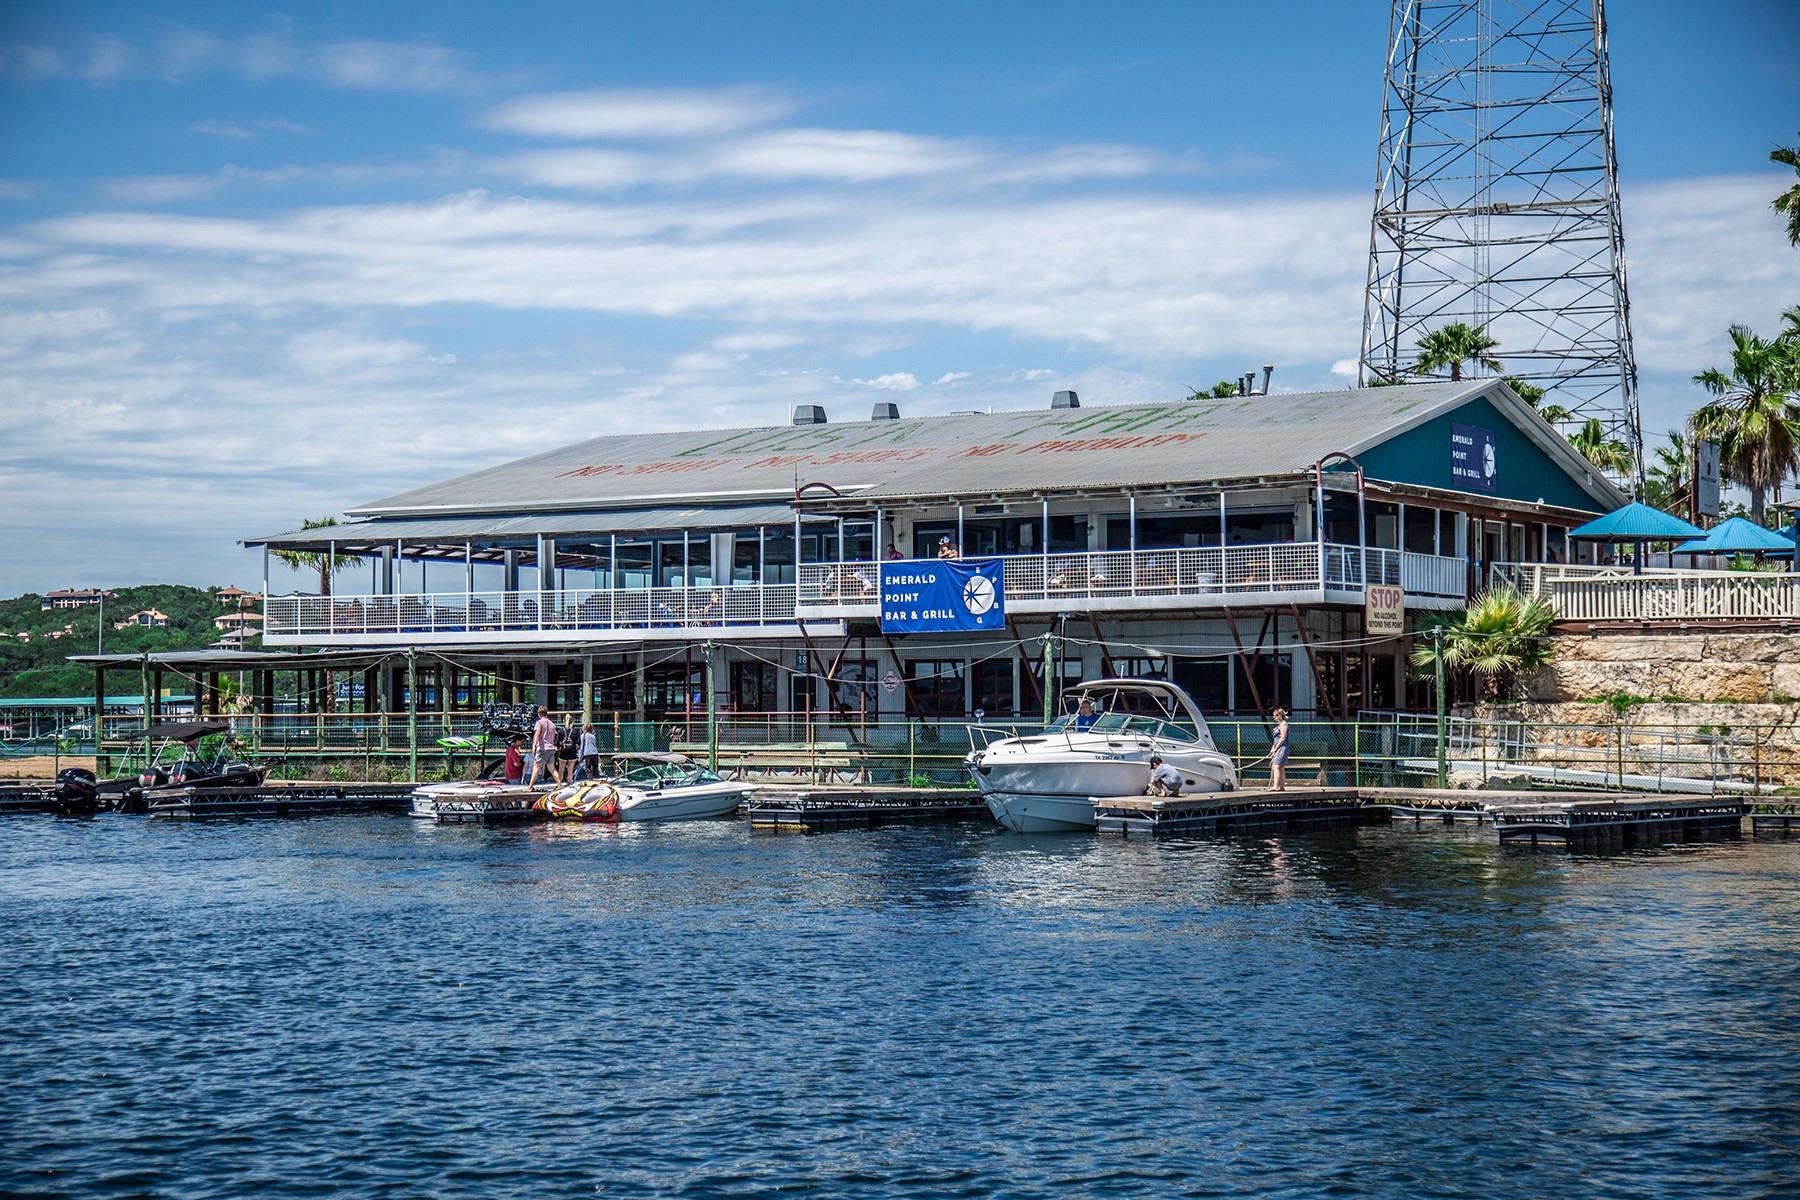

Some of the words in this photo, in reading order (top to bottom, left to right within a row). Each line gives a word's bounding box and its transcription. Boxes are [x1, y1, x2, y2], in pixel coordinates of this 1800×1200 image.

[1453, 434, 1473, 446] EMERALD
[1452, 450, 1467, 460] POINT
[1452, 466, 1462, 476] BAR
[1463, 467, 1467, 477] &
[1467, 469, 1481, 479] GRILL
[885, 574, 936, 586] EMERALD
[885, 593, 920, 603] POINT
[1371, 587, 1401, 609] STOP
[885, 611, 907, 621] BAR
[911, 610, 919, 620] &
[922, 609, 955, 619] GRILL
[1380, 612, 1398, 620] ALCOHOL
[1368, 620, 1383, 628] BEYOND
[1384, 620, 1392, 628] THIS
[1392, 621, 1403, 629] POINT
[798, 655, 807, 664] 18
